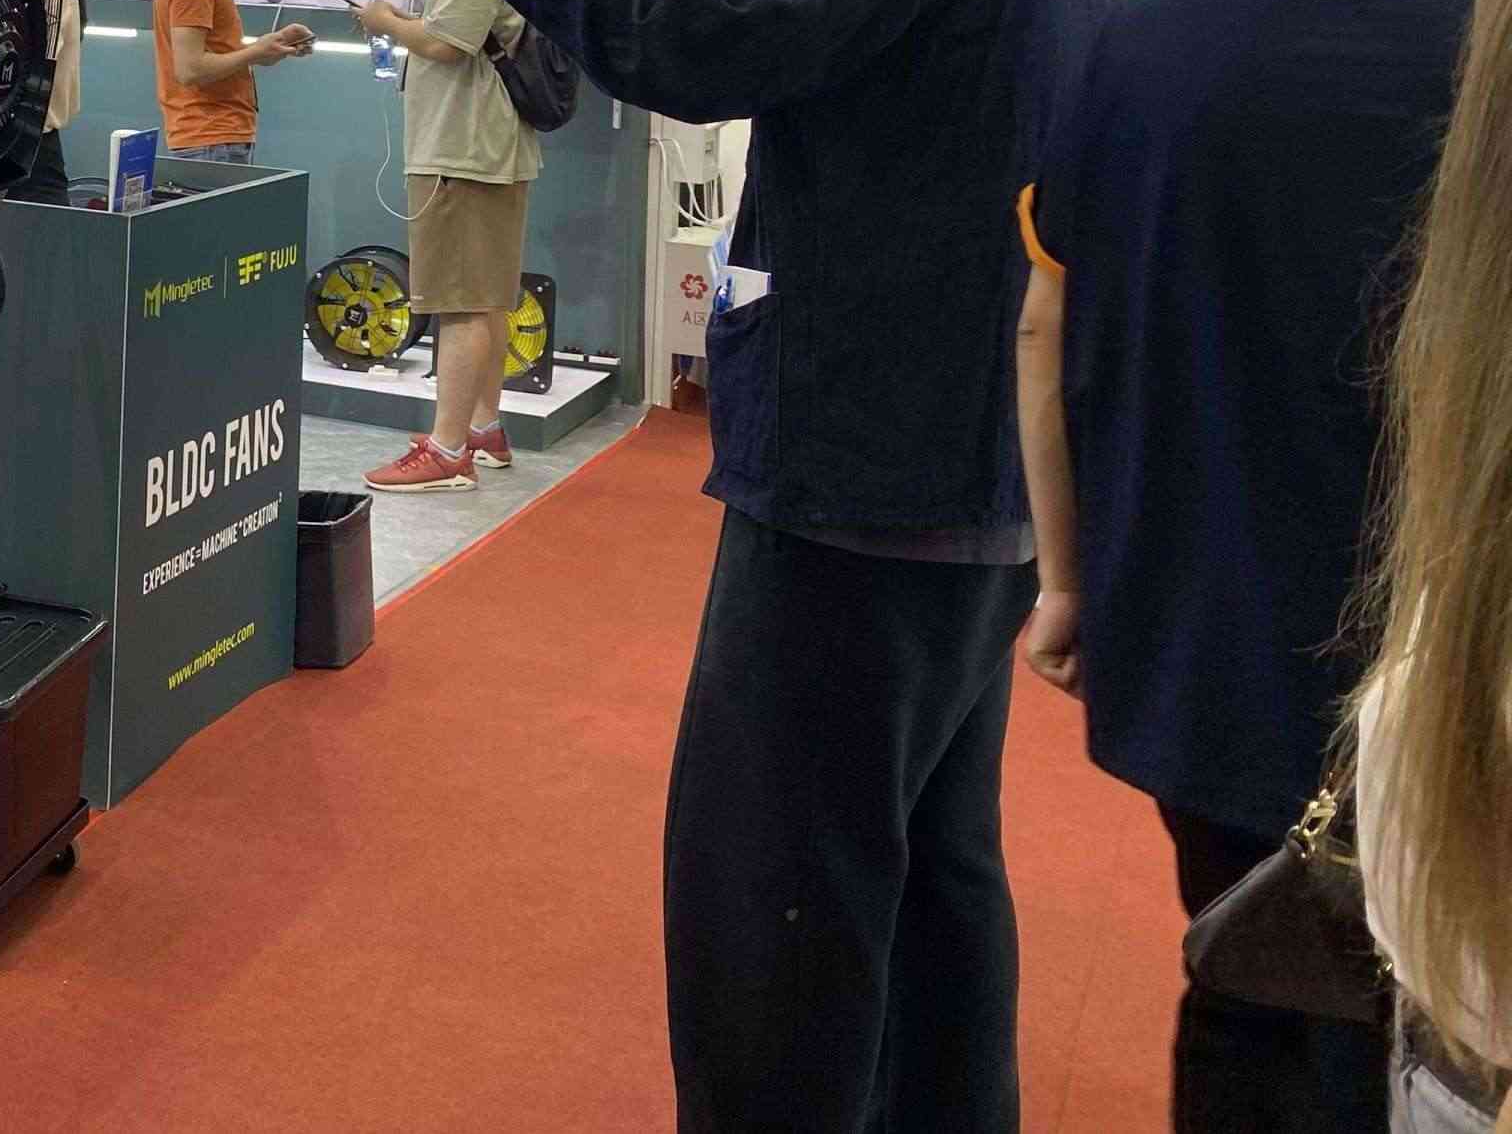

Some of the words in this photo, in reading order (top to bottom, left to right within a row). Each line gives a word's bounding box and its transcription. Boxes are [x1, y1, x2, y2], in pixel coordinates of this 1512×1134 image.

[162, 273, 214, 305] Mingletec
[270, 243, 297, 273] FUJU
[145, 431, 216, 528] BLDC
[224, 398, 286, 487] FANS
[167, 622, 255, 691] www.mingletec.com
